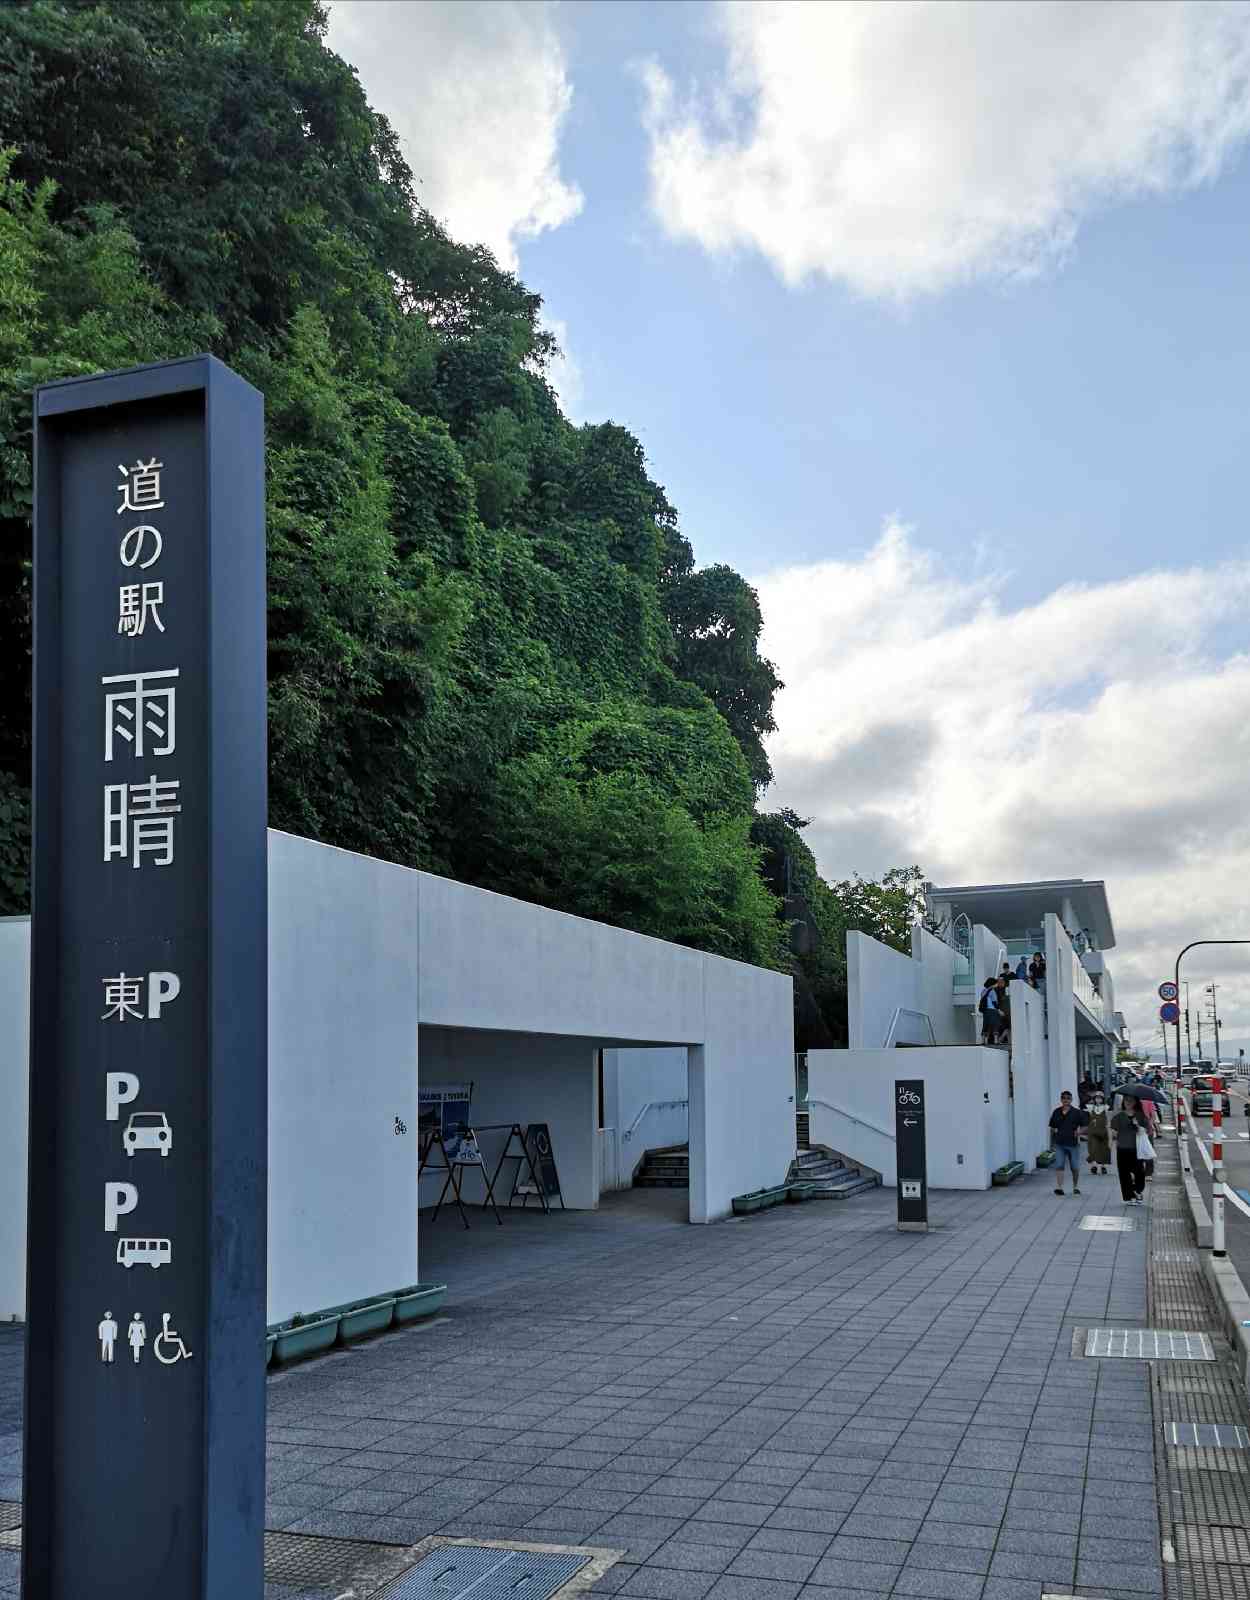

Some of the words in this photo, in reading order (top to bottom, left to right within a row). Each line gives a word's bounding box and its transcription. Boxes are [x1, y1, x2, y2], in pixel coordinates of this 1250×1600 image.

[116, 457, 166, 637] 道の駅
[101, 667, 182, 869] 雨晴
[1163, 986, 1175, 996] 50
[105, 1072, 140, 1121] P
[104, 1182, 139, 1232] P
